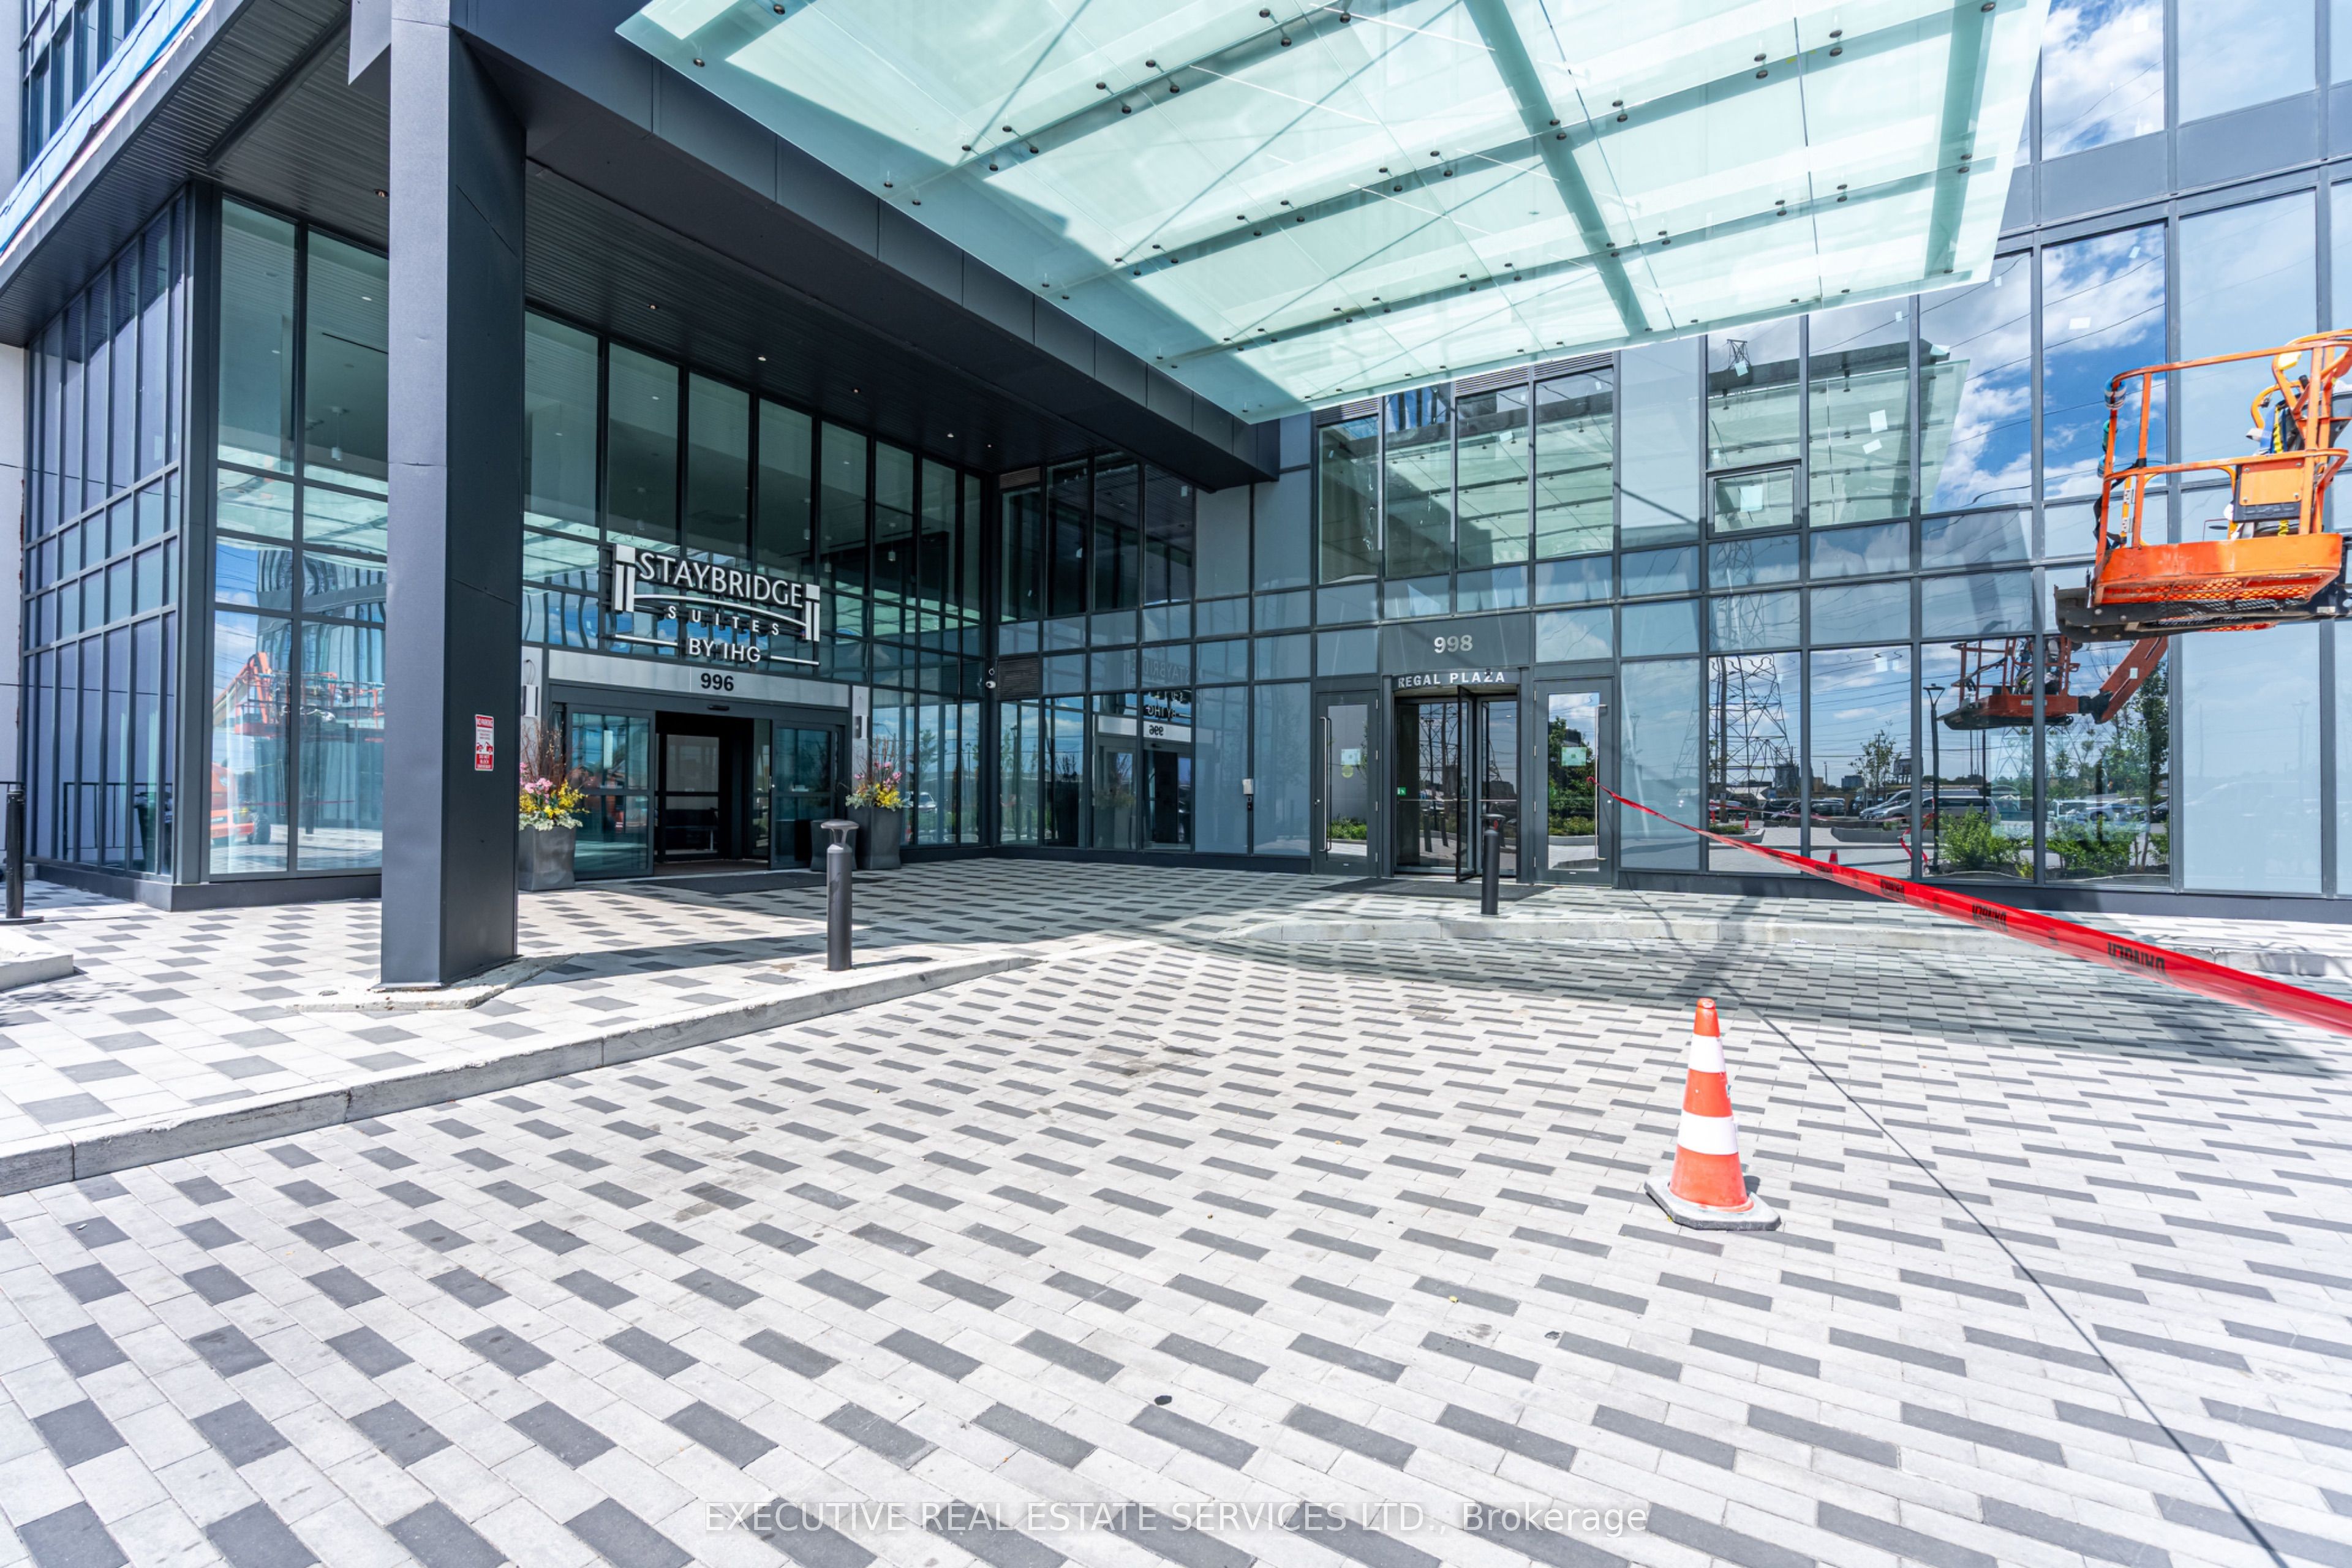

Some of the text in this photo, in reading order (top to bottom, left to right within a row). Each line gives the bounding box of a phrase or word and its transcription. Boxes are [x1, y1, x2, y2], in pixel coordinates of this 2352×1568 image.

[639, 552, 803, 608] STAYBRIDGE
[668, 605, 780, 636] SUITES
[689, 638, 761, 663] BY IHG
[1434, 635, 1473, 654] 998
[701, 673, 734, 692] 996
[1398, 672, 1505, 688] REGAL PLAZA
